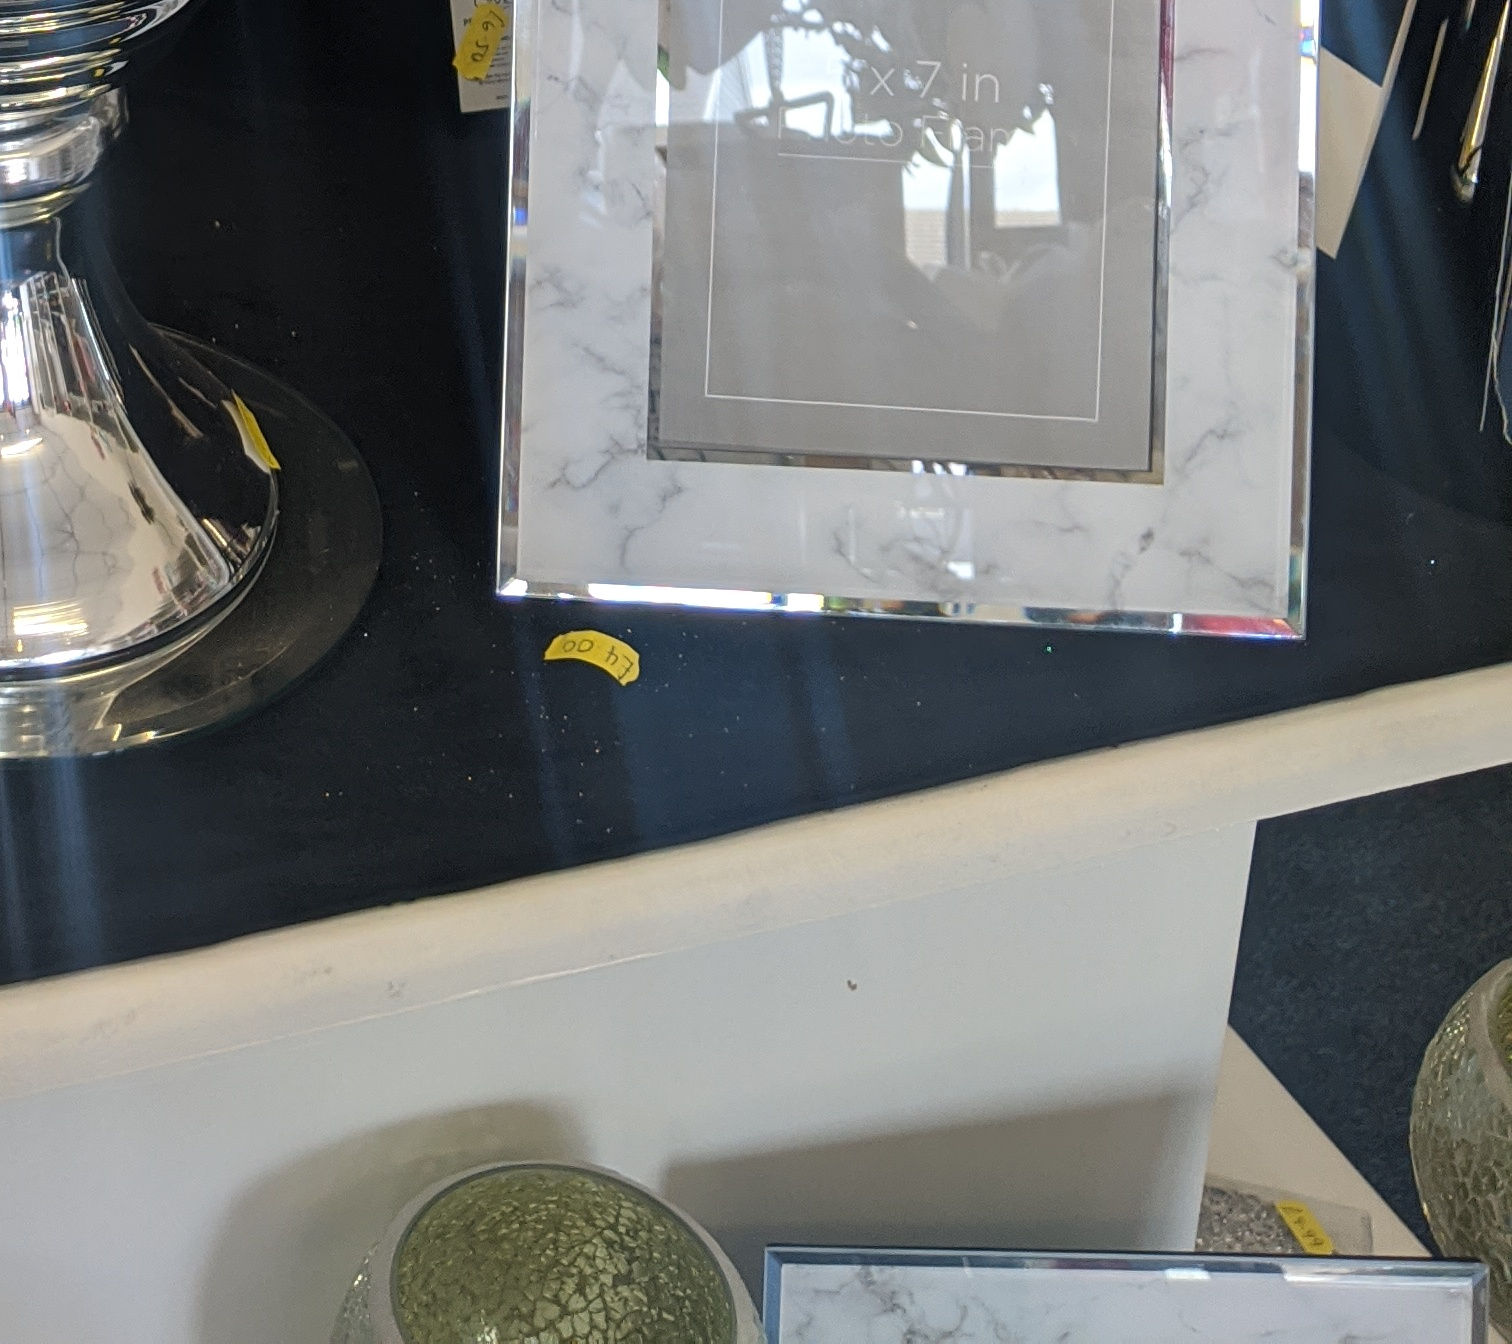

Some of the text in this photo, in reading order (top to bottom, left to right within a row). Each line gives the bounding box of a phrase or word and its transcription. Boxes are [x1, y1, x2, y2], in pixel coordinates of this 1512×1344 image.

[870, 60, 1000, 104] x 7 in
